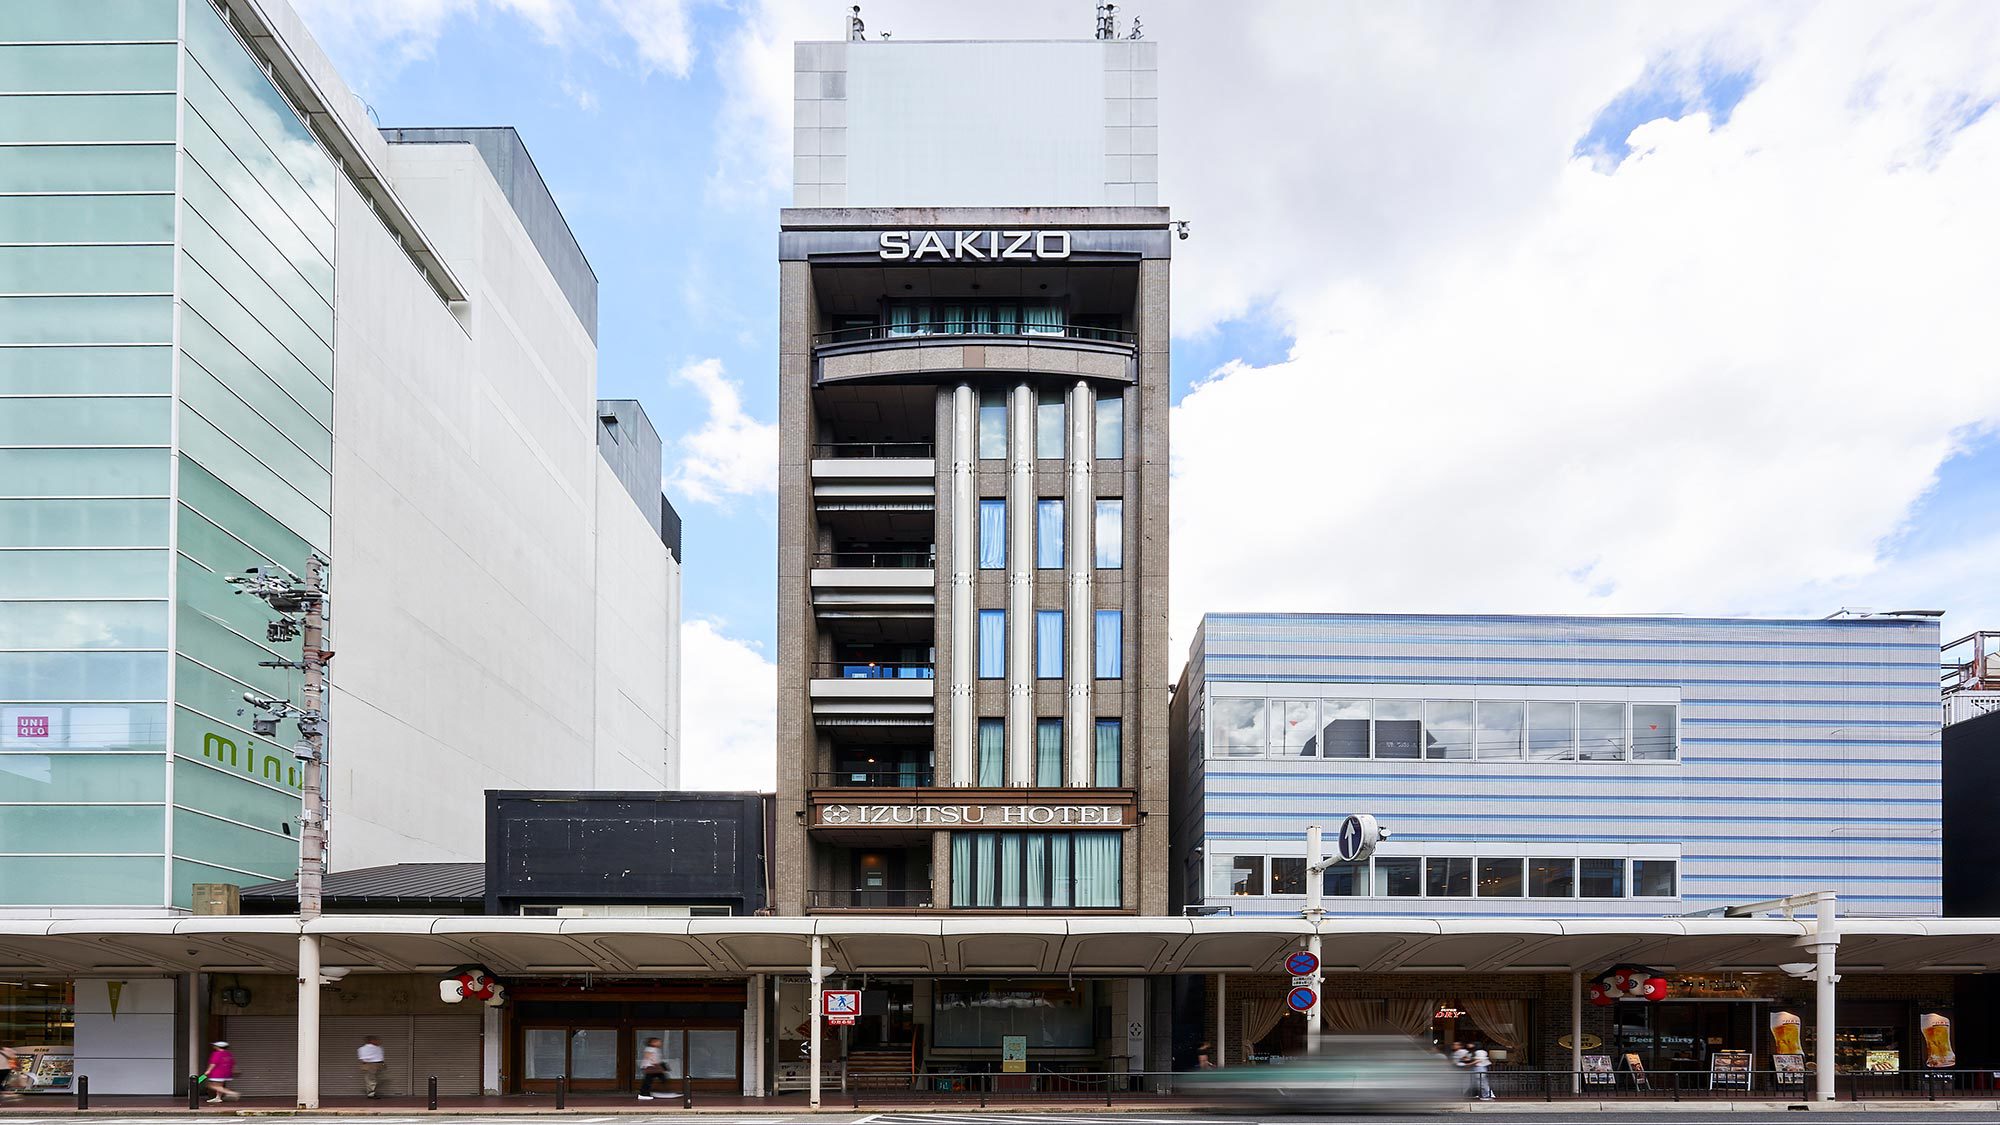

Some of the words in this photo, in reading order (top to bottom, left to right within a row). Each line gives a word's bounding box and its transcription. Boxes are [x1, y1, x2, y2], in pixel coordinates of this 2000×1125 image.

[879, 230, 1071, 260] SAKIZO
[21, 719, 43, 727] UNI
[21, 727, 46, 737] QLO
[857, 804, 987, 824] IZUTSU
[1001, 805, 1122, 824] HOTEL
[1660, 1036, 1695, 1044] Thirty
